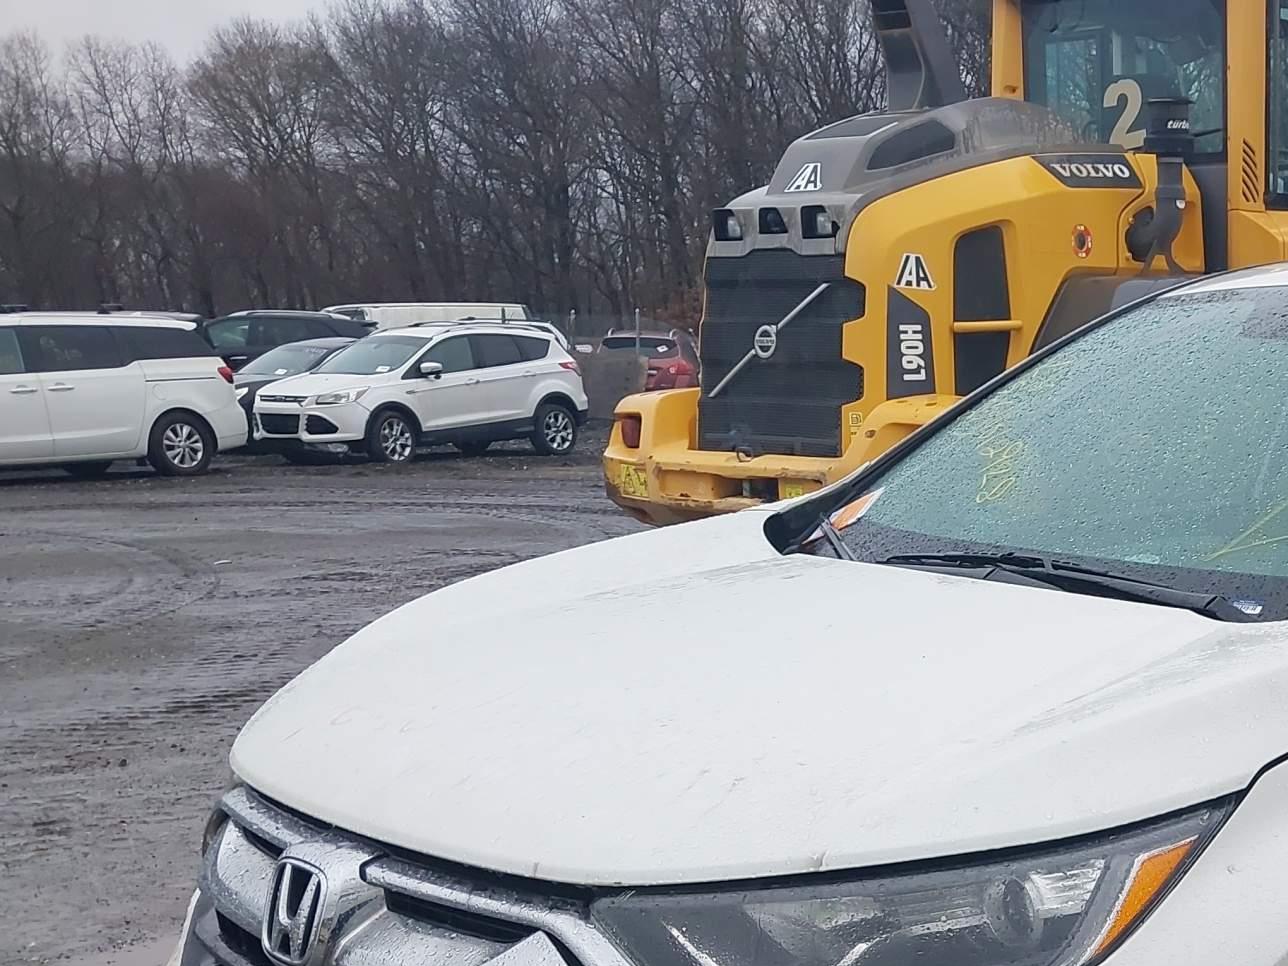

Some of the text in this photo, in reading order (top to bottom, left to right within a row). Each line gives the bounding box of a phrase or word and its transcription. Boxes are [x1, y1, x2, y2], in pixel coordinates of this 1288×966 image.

[1103, 79, 1147, 150] 2
[1050, 163, 1130, 178] VOLVO
[898, 323, 927, 382] L90H
